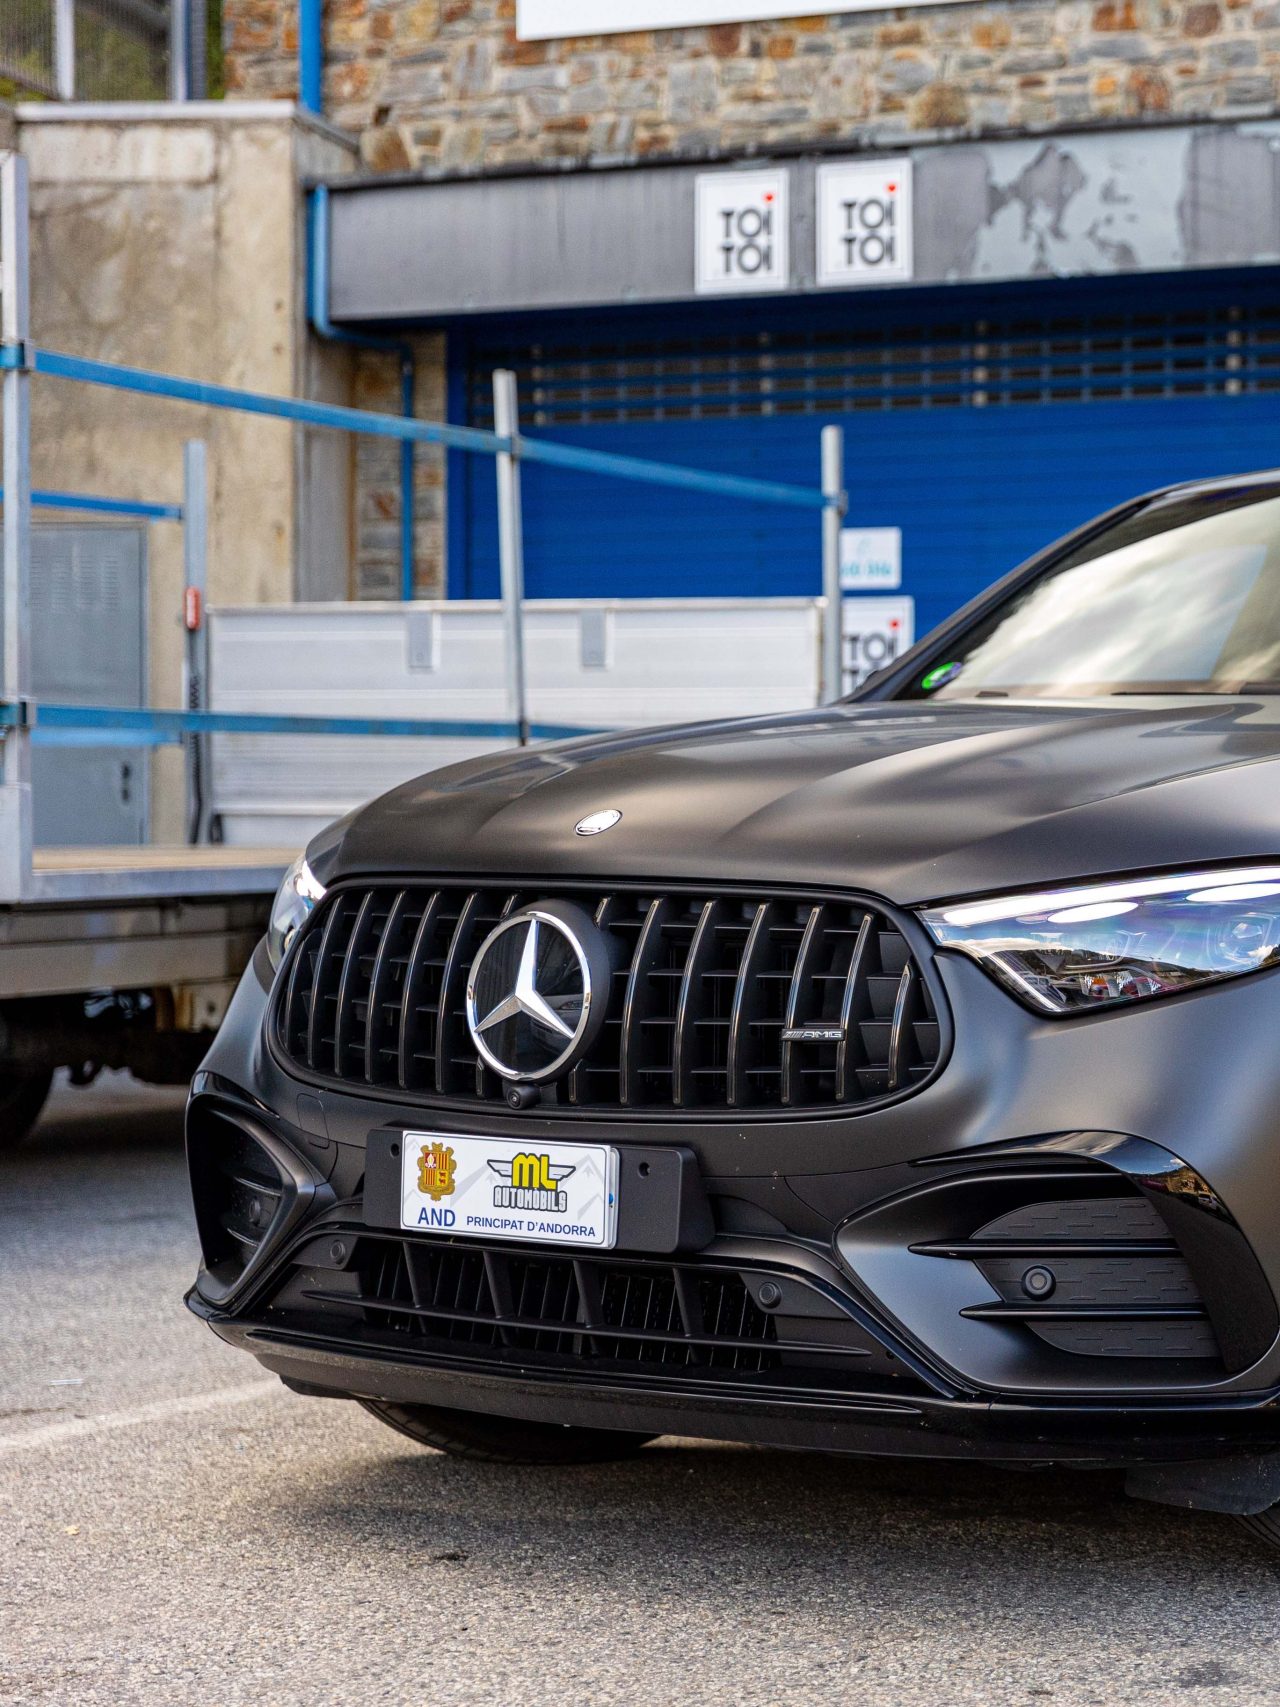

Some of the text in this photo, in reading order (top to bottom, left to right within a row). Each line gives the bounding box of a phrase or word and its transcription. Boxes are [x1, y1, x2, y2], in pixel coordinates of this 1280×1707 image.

[512, 1152, 559, 1190] ML
[417, 1207, 456, 1227] AND
[466, 1215, 596, 1237] PRINCIPAT D'ANDORRA
